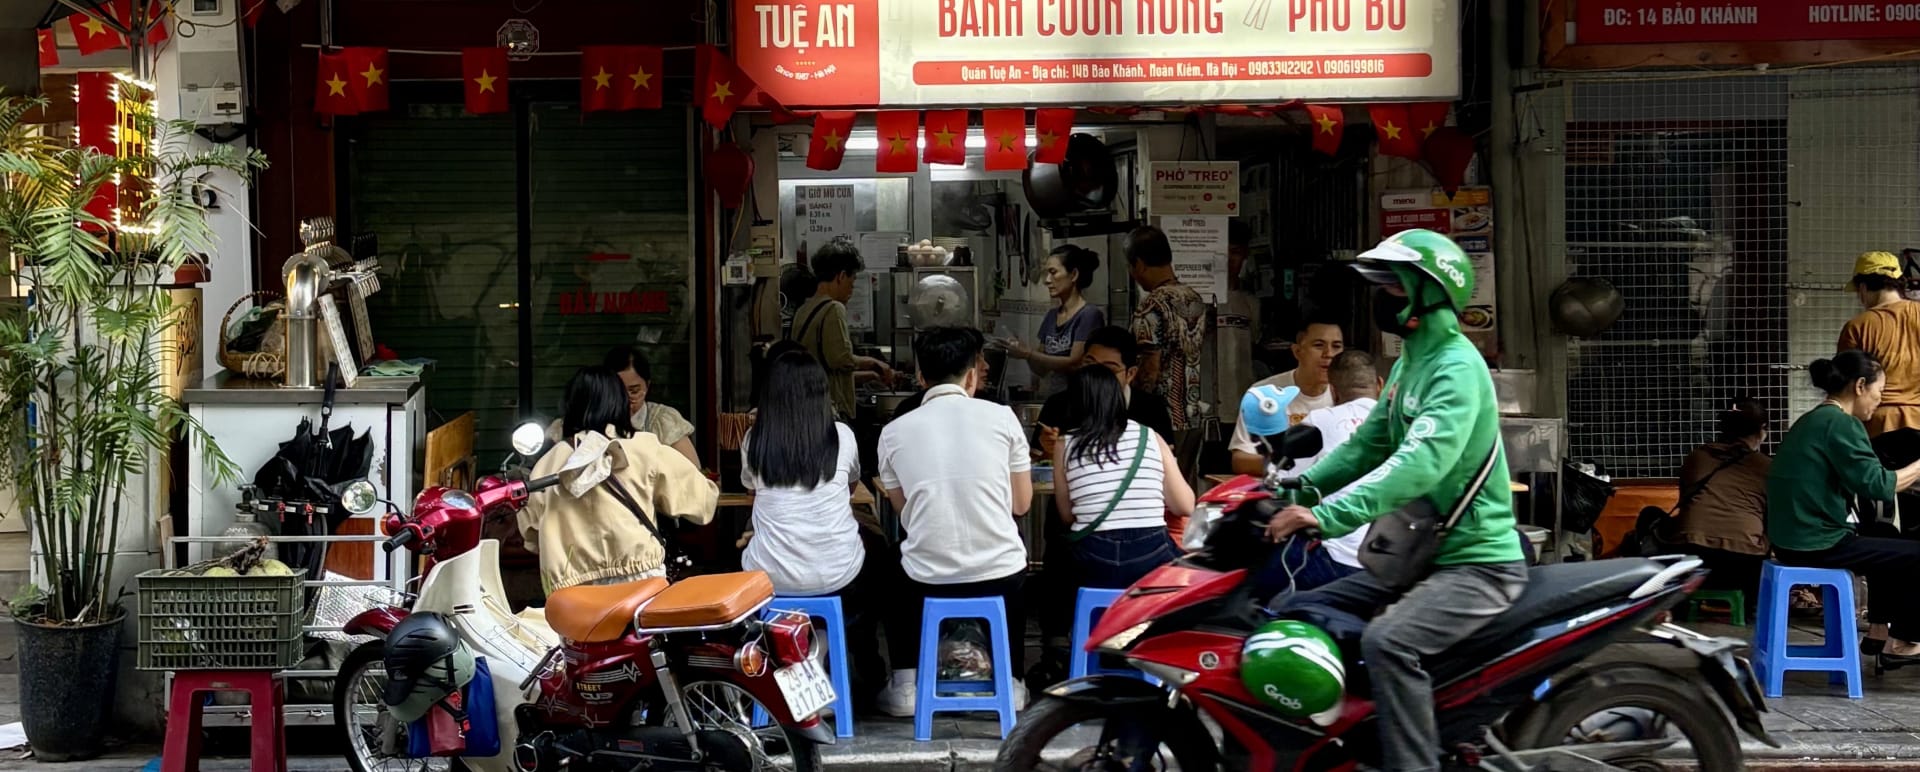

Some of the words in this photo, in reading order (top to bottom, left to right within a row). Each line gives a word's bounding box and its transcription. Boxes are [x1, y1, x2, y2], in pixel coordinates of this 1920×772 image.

[1604, 8, 1632, 26] ĐC:
[1637, 8, 1657, 26] 14
[1701, 4, 1758, 25] KHÁNH
[1808, 4, 1880, 23] HOTLINE:
[754, 4, 809, 54] TUỆ
[815, 3, 855, 48] AN
[961, 65, 987, 82] Quán
[989, 65, 1006, 82] Tuệ
[1009, 64, 1021, 80] An
[1032, 64, 1048, 81] Địa
[1072, 63, 1089, 79] 14B
[1206, 62, 1219, 77] Hà
[1221, 61, 1237, 78] Nội
[1248, 60, 1314, 76] 0983342242
[1323, 59, 1385, 75] 0906199816
[1156, 167, 1186, 181] PHỞ
[1187, 169, 1233, 181] "TREO"
[1435, 254, 1465, 288] Grab
[1263, 684, 1303, 710] Grab
